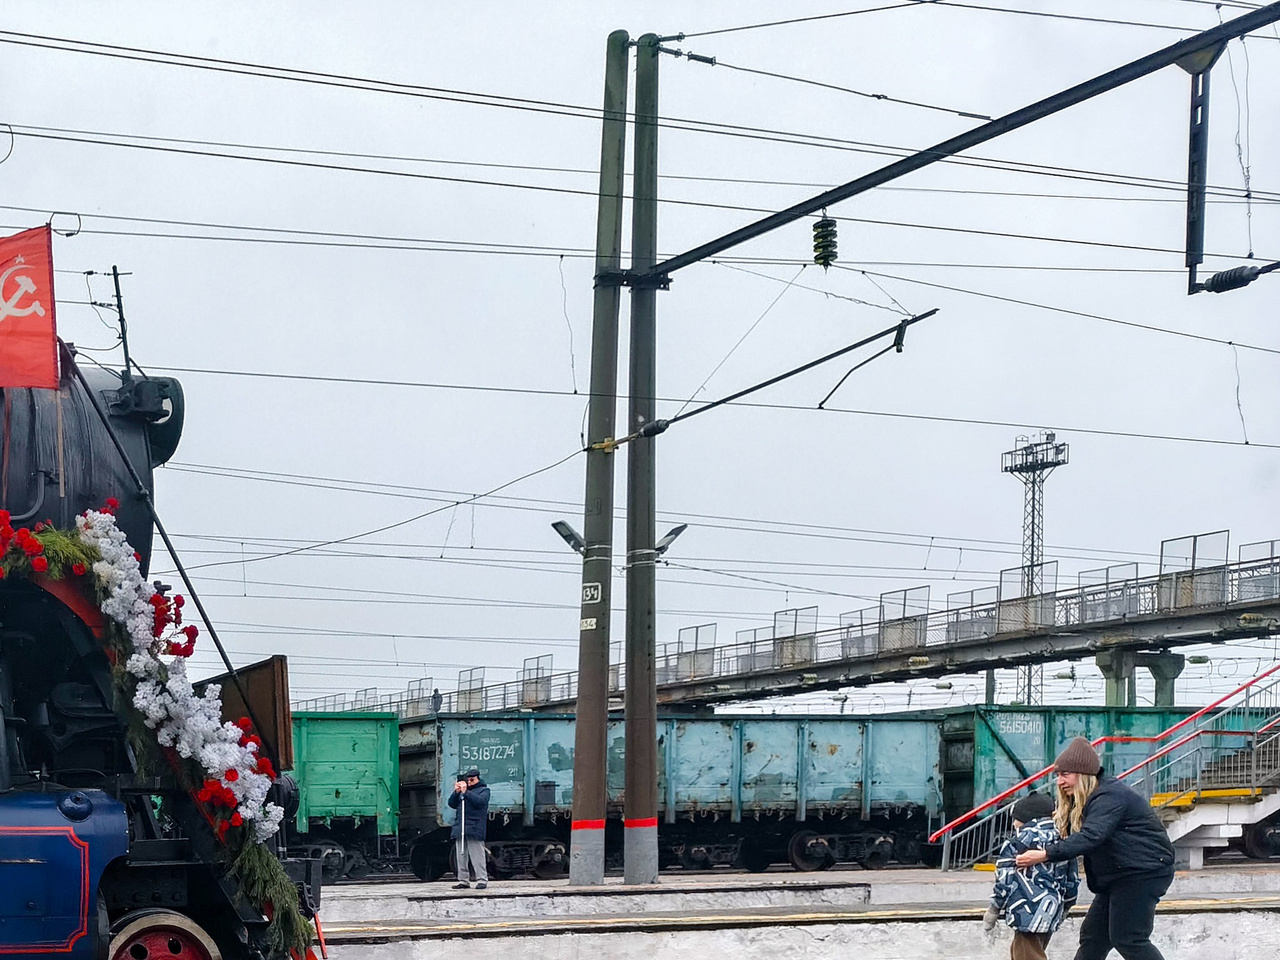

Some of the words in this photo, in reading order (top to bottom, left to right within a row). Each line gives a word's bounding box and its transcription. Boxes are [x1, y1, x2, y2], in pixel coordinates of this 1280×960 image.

[583, 587, 598, 600] 134
[999, 721, 1041, 734] 56150410
[462, 744, 515, 760] 53187274
